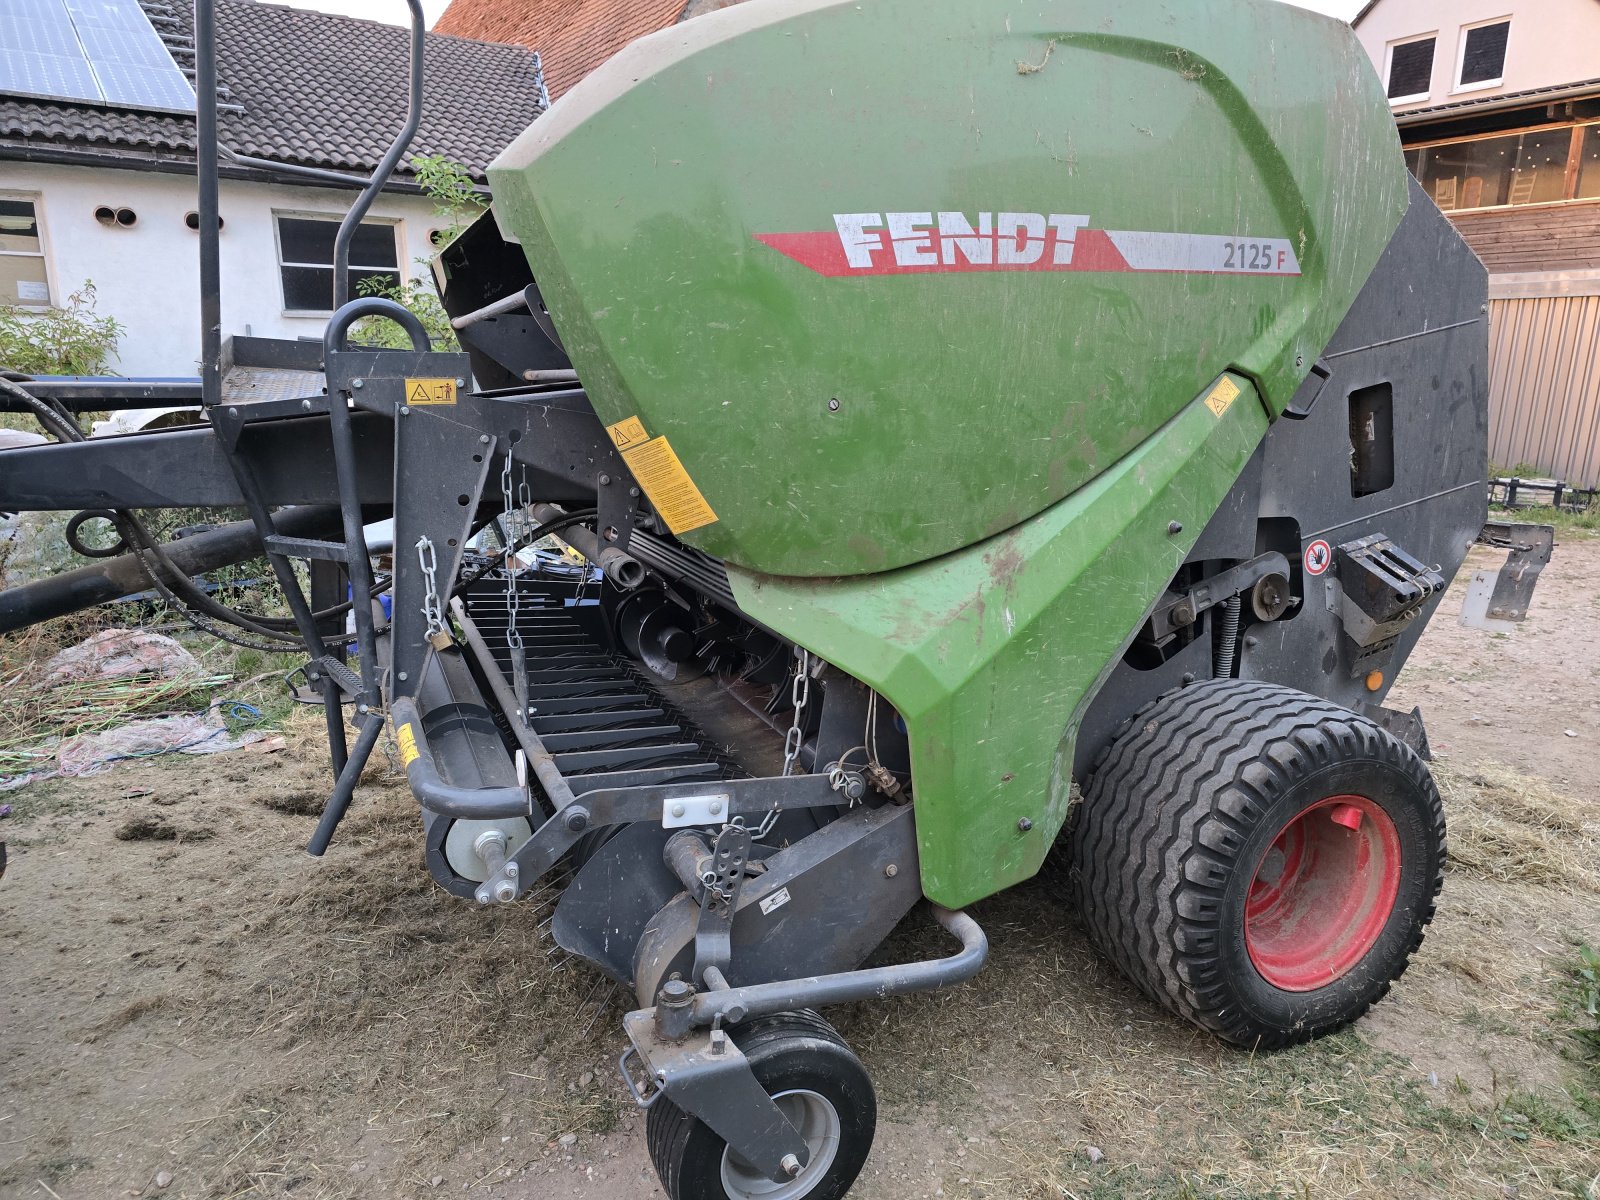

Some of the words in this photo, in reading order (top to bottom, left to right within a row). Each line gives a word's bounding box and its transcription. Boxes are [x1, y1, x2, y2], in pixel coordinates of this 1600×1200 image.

[833, 211, 1091, 269] FENDT
[1224, 242, 1271, 271] 2125
[1277, 250, 1286, 271] F
